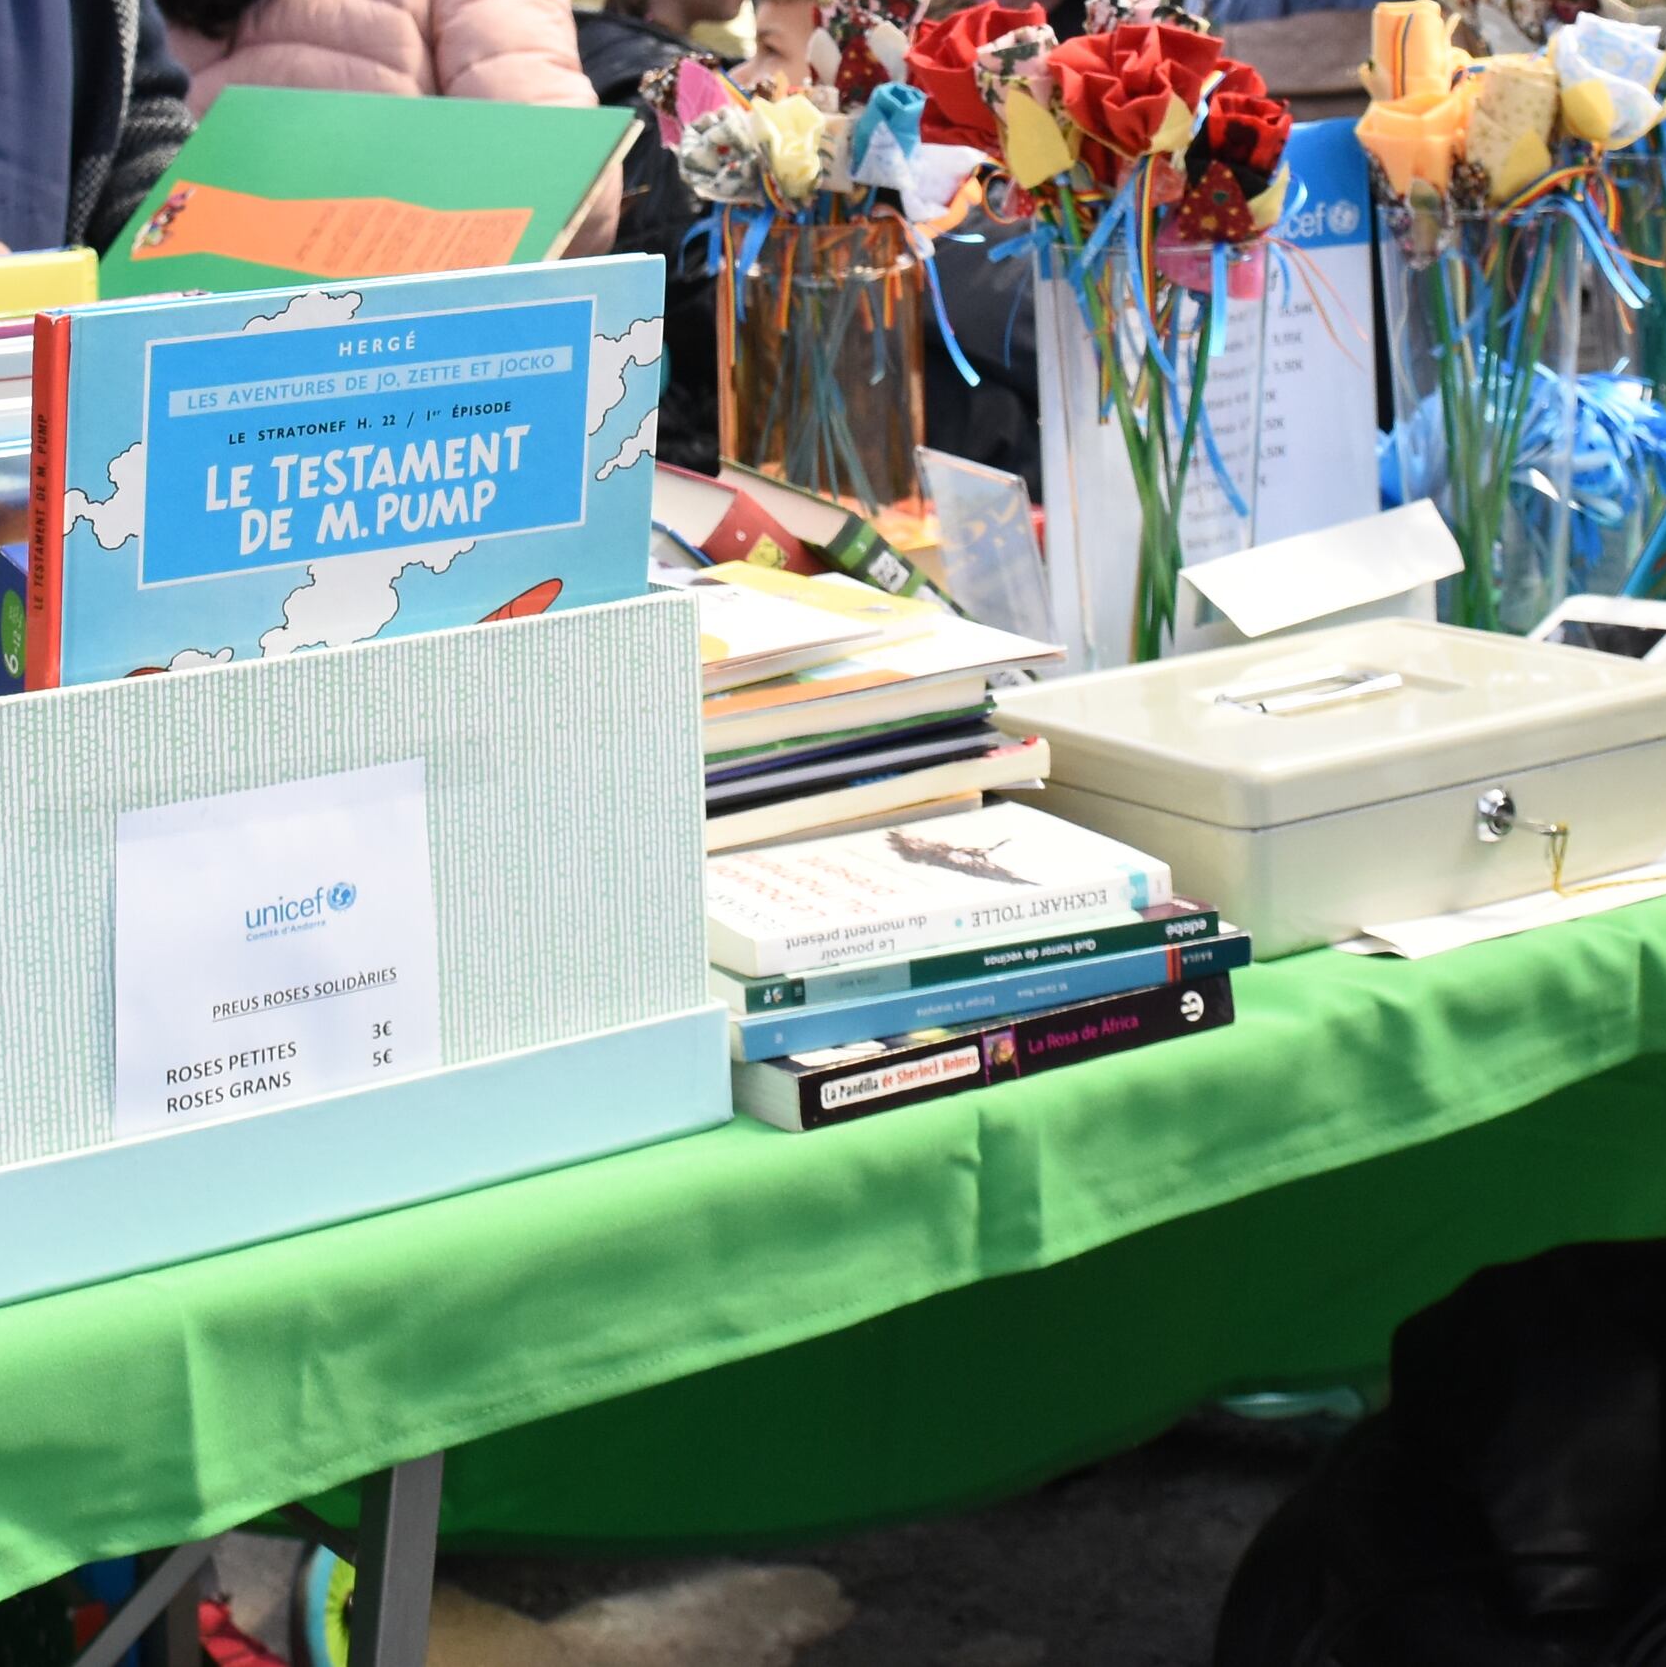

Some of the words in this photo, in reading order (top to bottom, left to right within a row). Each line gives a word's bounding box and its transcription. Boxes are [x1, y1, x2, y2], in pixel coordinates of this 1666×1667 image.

[338, 330, 417, 358] HERGÉ
[186, 390, 219, 411] LES
[227, 378, 336, 406] AVENTURES
[344, 374, 370, 394] DE
[374, 371, 402, 394] JO,
[407, 363, 462, 386] ZETTE
[470, 359, 491, 378] ET
[495, 353, 555, 380] JOCKO
[37, 414, 49, 455] PUMP
[227, 431, 247, 446] LE
[257, 418, 348, 443] STRATONEF
[356, 416, 373, 431] H.
[381, 413, 396, 428] 22
[450, 400, 513, 421] ÉPISODE
[36, 460, 48, 479] M.
[205, 464, 254, 513] LE
[270, 425, 532, 504] TESTAMENT
[35, 483, 47, 503] DE
[238, 507, 293, 557] DE
[375, 480, 498, 536] PUMP
[34, 509, 47, 590] TESTAMENT
[33, 595, 45, 612] LE
[244, 886, 325, 930] unicef
[907, 913, 928, 928] du
[971, 905, 1024, 929] TOLLE
[1028, 889, 1109, 922] ECKHART
[785, 926, 841, 951] présent
[845, 918, 905, 939] moment
[1165, 918, 1208, 938] edebé
[821, 940, 876, 962] pouvoir
[879, 937, 896, 953] Le
[212, 995, 260, 1020] PREUS
[262, 985, 311, 1010] ROSES
[313, 966, 398, 998] SOLIDÀRIES
[165, 1057, 224, 1086] ROSES
[228, 1040, 298, 1071] PETITES
[371, 1020, 393, 1040] 3€
[1028, 1037, 1044, 1055] La
[1046, 1030, 1079, 1051] Rosa
[1081, 1023, 1099, 1042] de
[166, 1086, 225, 1115] ROSES
[229, 1070, 293, 1101] GRANS
[371, 1048, 394, 1069] 5€
[823, 1086, 837, 1104] La
[839, 1077, 879, 1100] Pandilla
[881, 1072, 894, 1088] de
